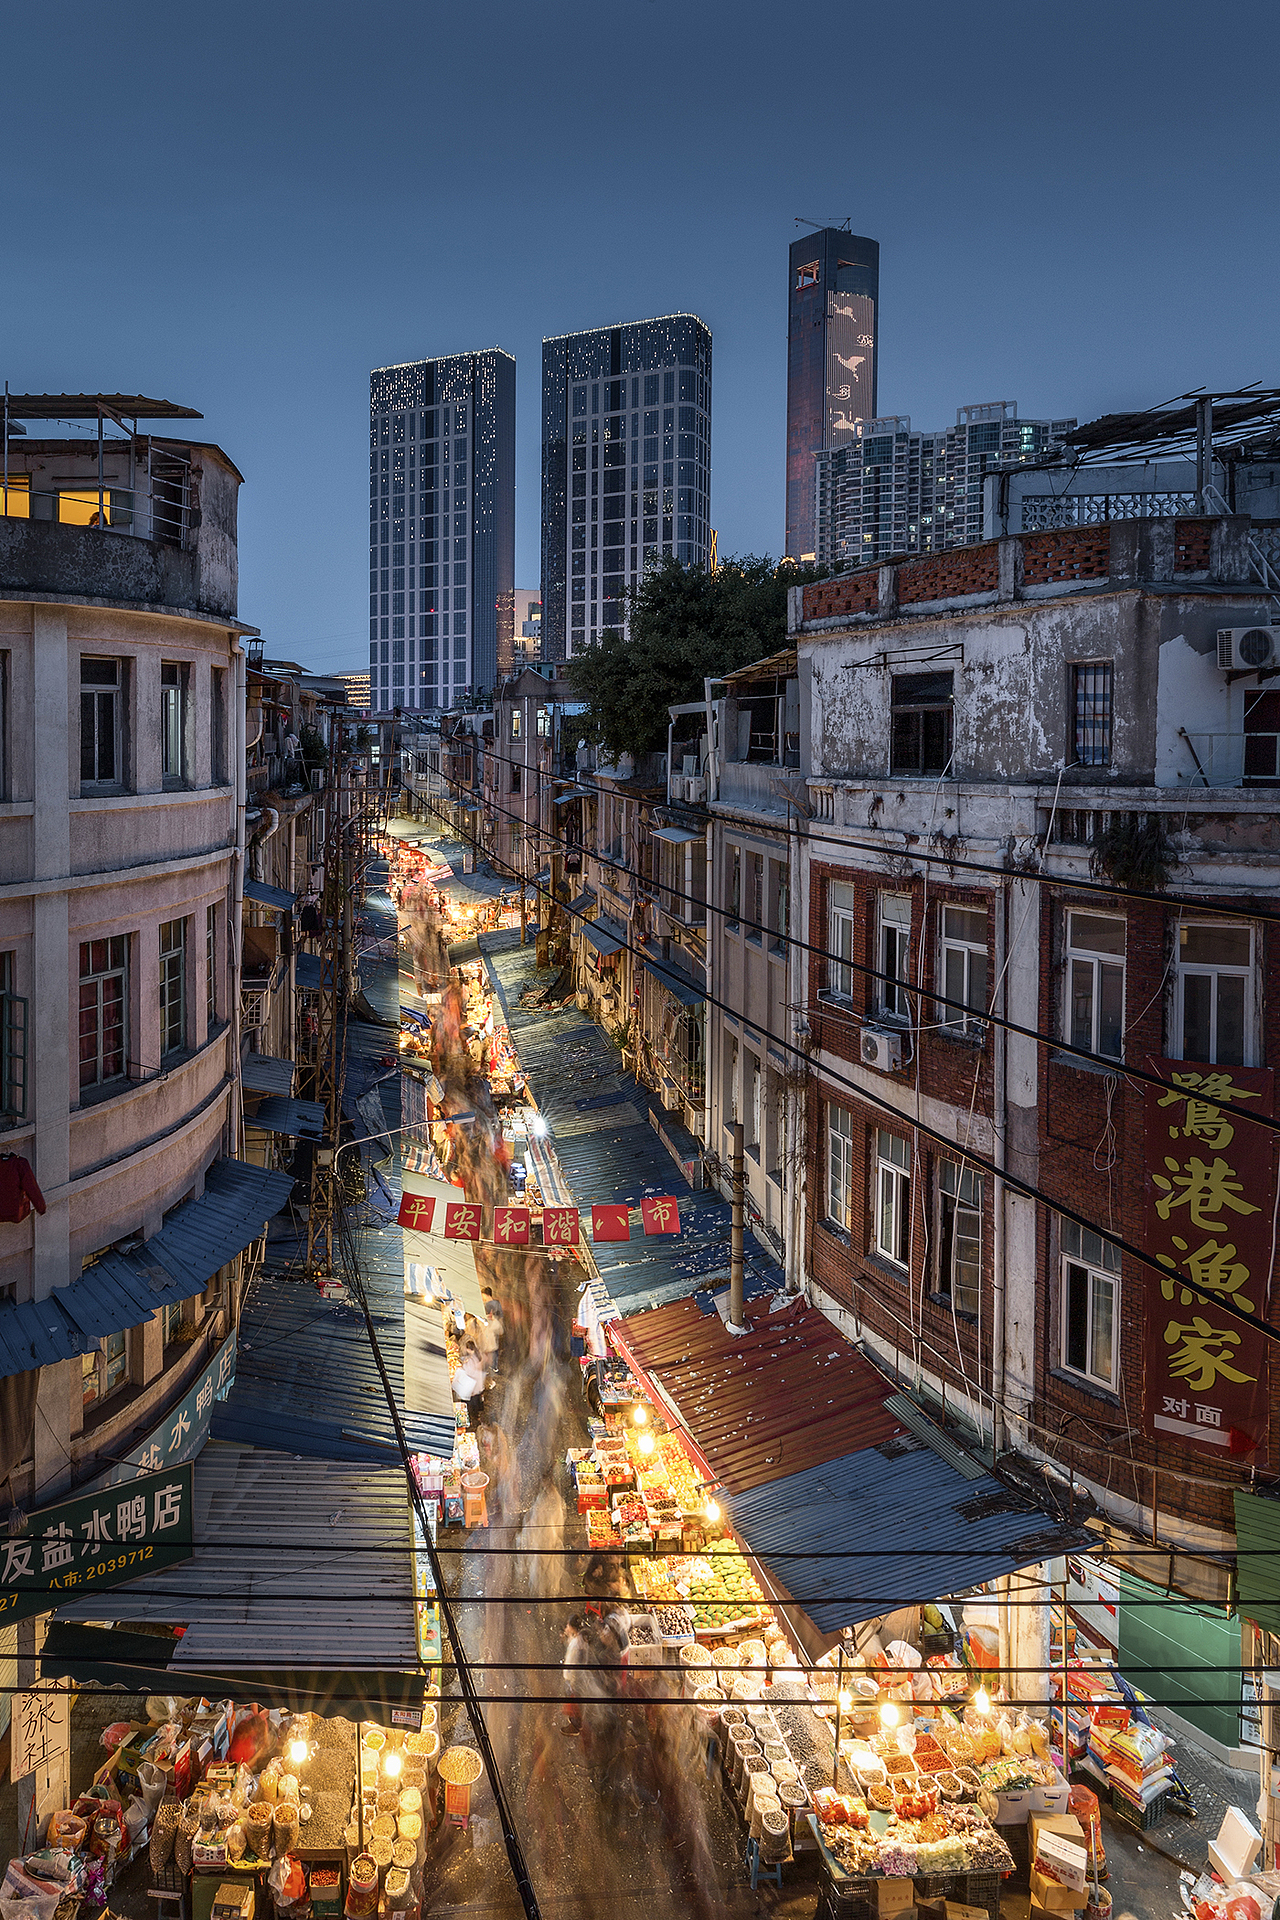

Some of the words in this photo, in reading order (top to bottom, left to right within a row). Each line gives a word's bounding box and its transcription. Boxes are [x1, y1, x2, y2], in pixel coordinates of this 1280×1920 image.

[403, 1197, 673, 1243] 平安和谐八市
[1162, 1396, 1223, 1427] 对面
